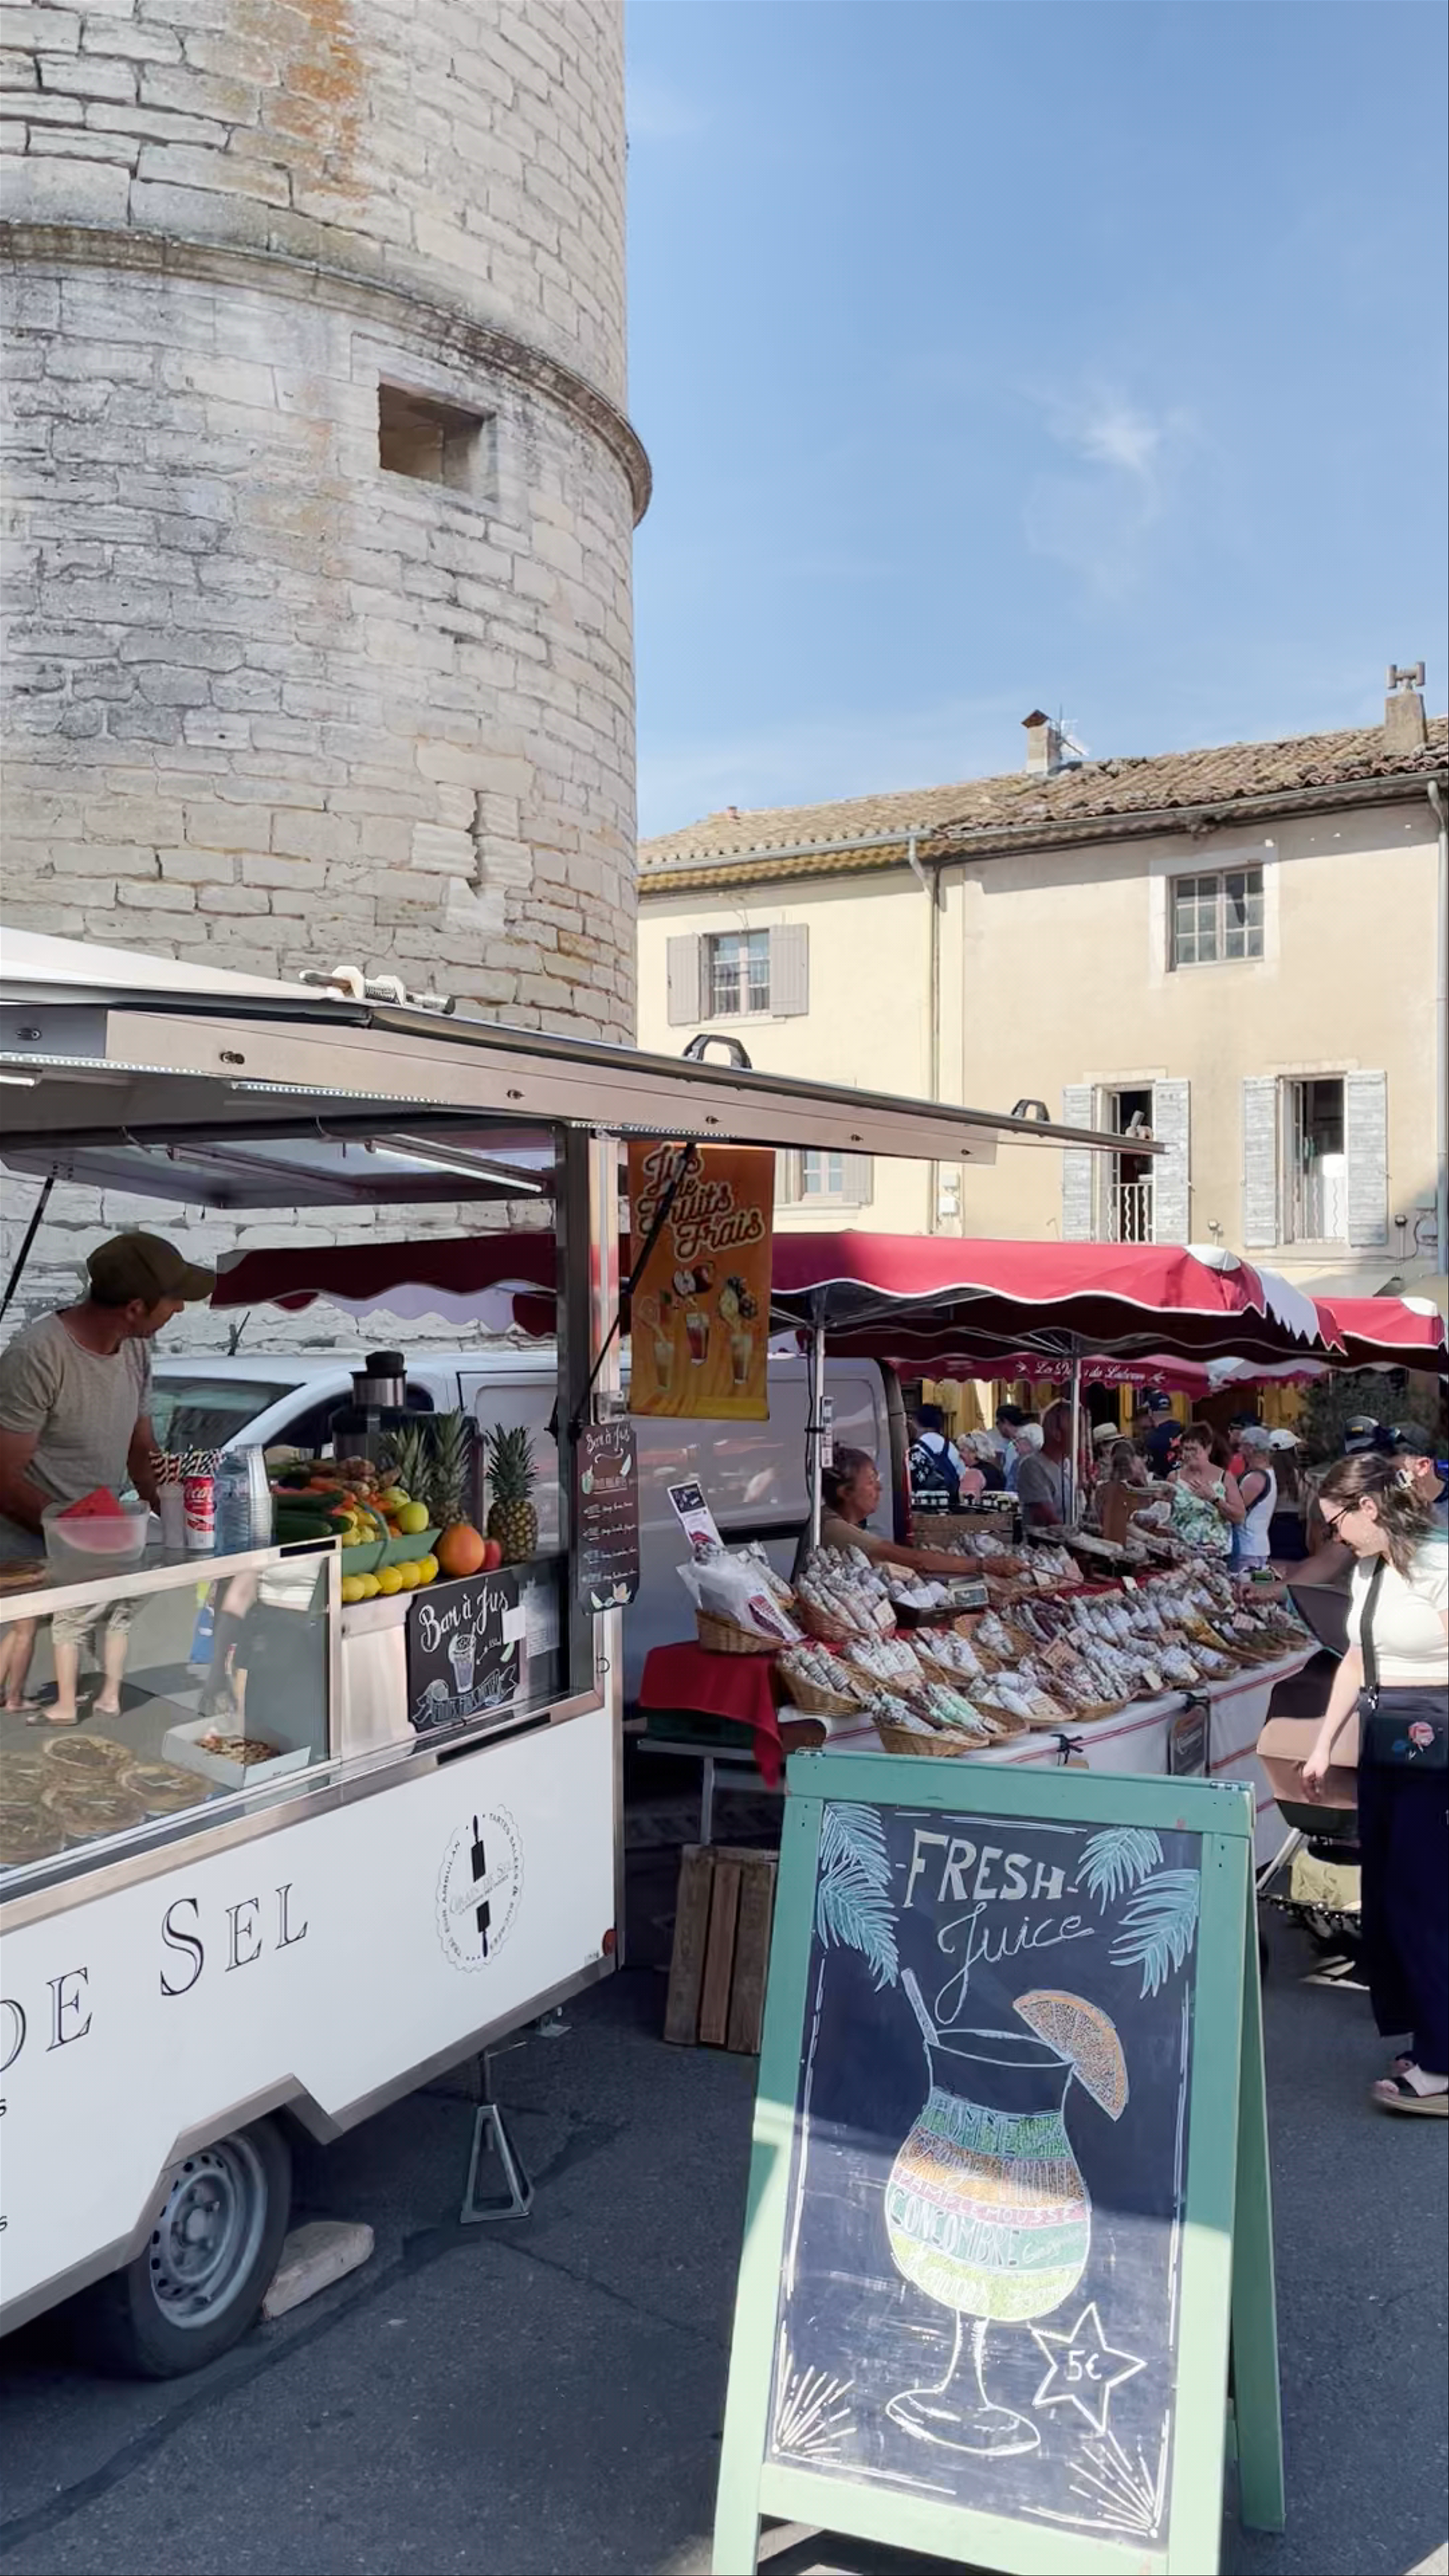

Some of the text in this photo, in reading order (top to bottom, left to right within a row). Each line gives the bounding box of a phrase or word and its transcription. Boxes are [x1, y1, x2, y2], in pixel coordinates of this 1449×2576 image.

[675, 1209, 764, 1261] Frais
[419, 1577, 509, 1652] Bar à Jus
[160, 1883, 308, 1996] SEL
[935, 1902, 1095, 2025] Juice
[891, 2188, 1020, 2265] CONCOMBRE
